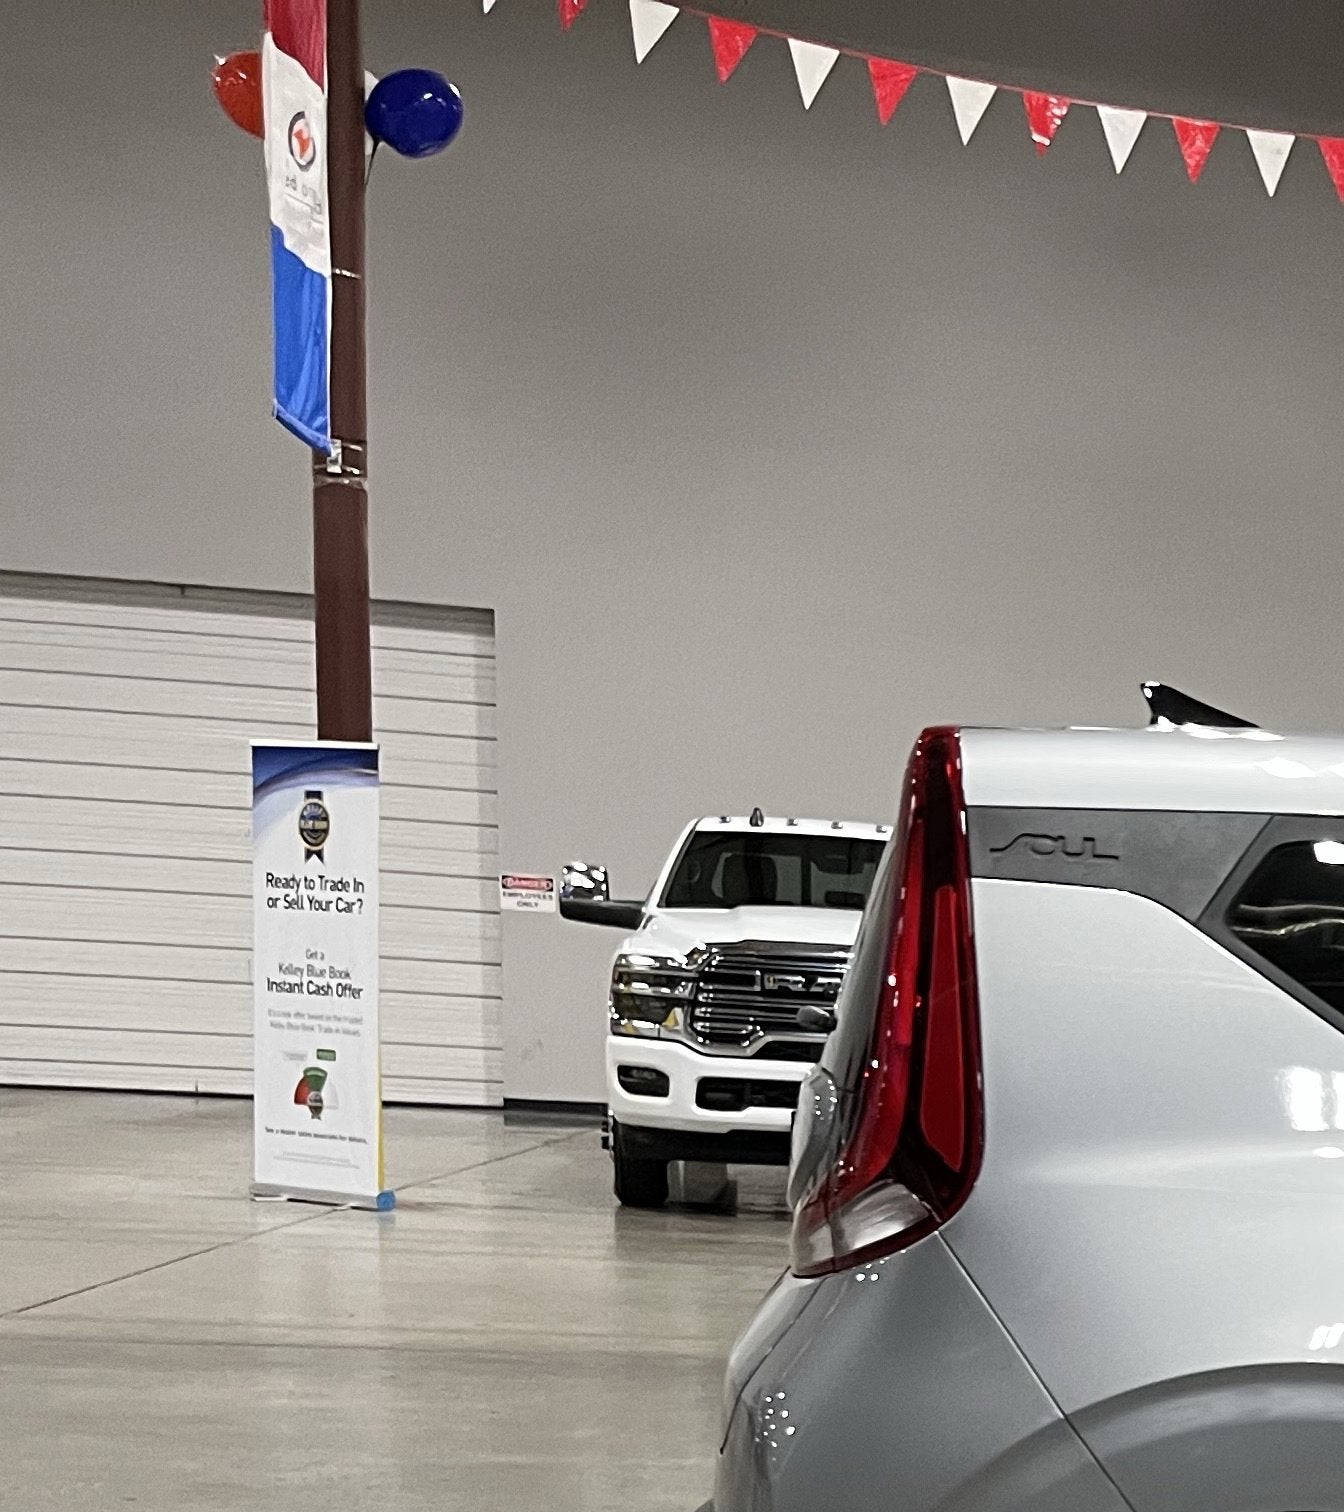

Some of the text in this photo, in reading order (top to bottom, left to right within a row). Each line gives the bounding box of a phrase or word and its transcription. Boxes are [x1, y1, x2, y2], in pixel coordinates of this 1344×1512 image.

[265, 872, 364, 896] Ready to Trade In
[266, 893, 363, 915] or Sell Your Car?
[306, 964, 327, 978] Blue
[266, 977, 364, 1000] Instant Cash Offer
